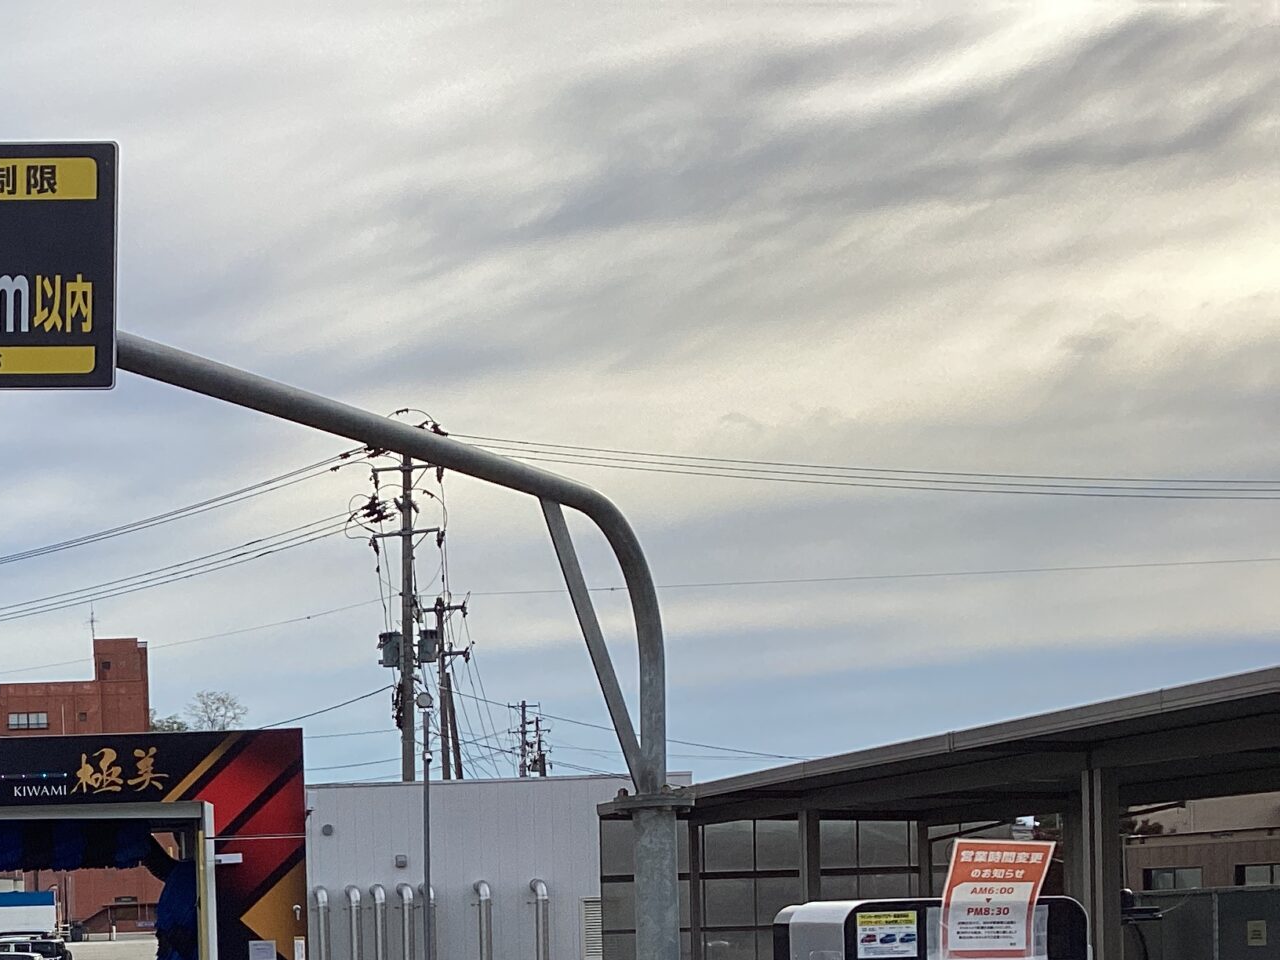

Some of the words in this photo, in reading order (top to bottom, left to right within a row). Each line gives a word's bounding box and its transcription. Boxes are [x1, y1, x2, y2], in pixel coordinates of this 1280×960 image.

[13, 784, 67, 797] KIWAMI
[70, 746, 170, 794] 極美
[960, 850, 1045, 864] 営業時間変更
[970, 868, 1025, 879] のお知らせ
[970, 886, 1015, 895] AM6:00
[966, 906, 1010, 916] PM8:30
